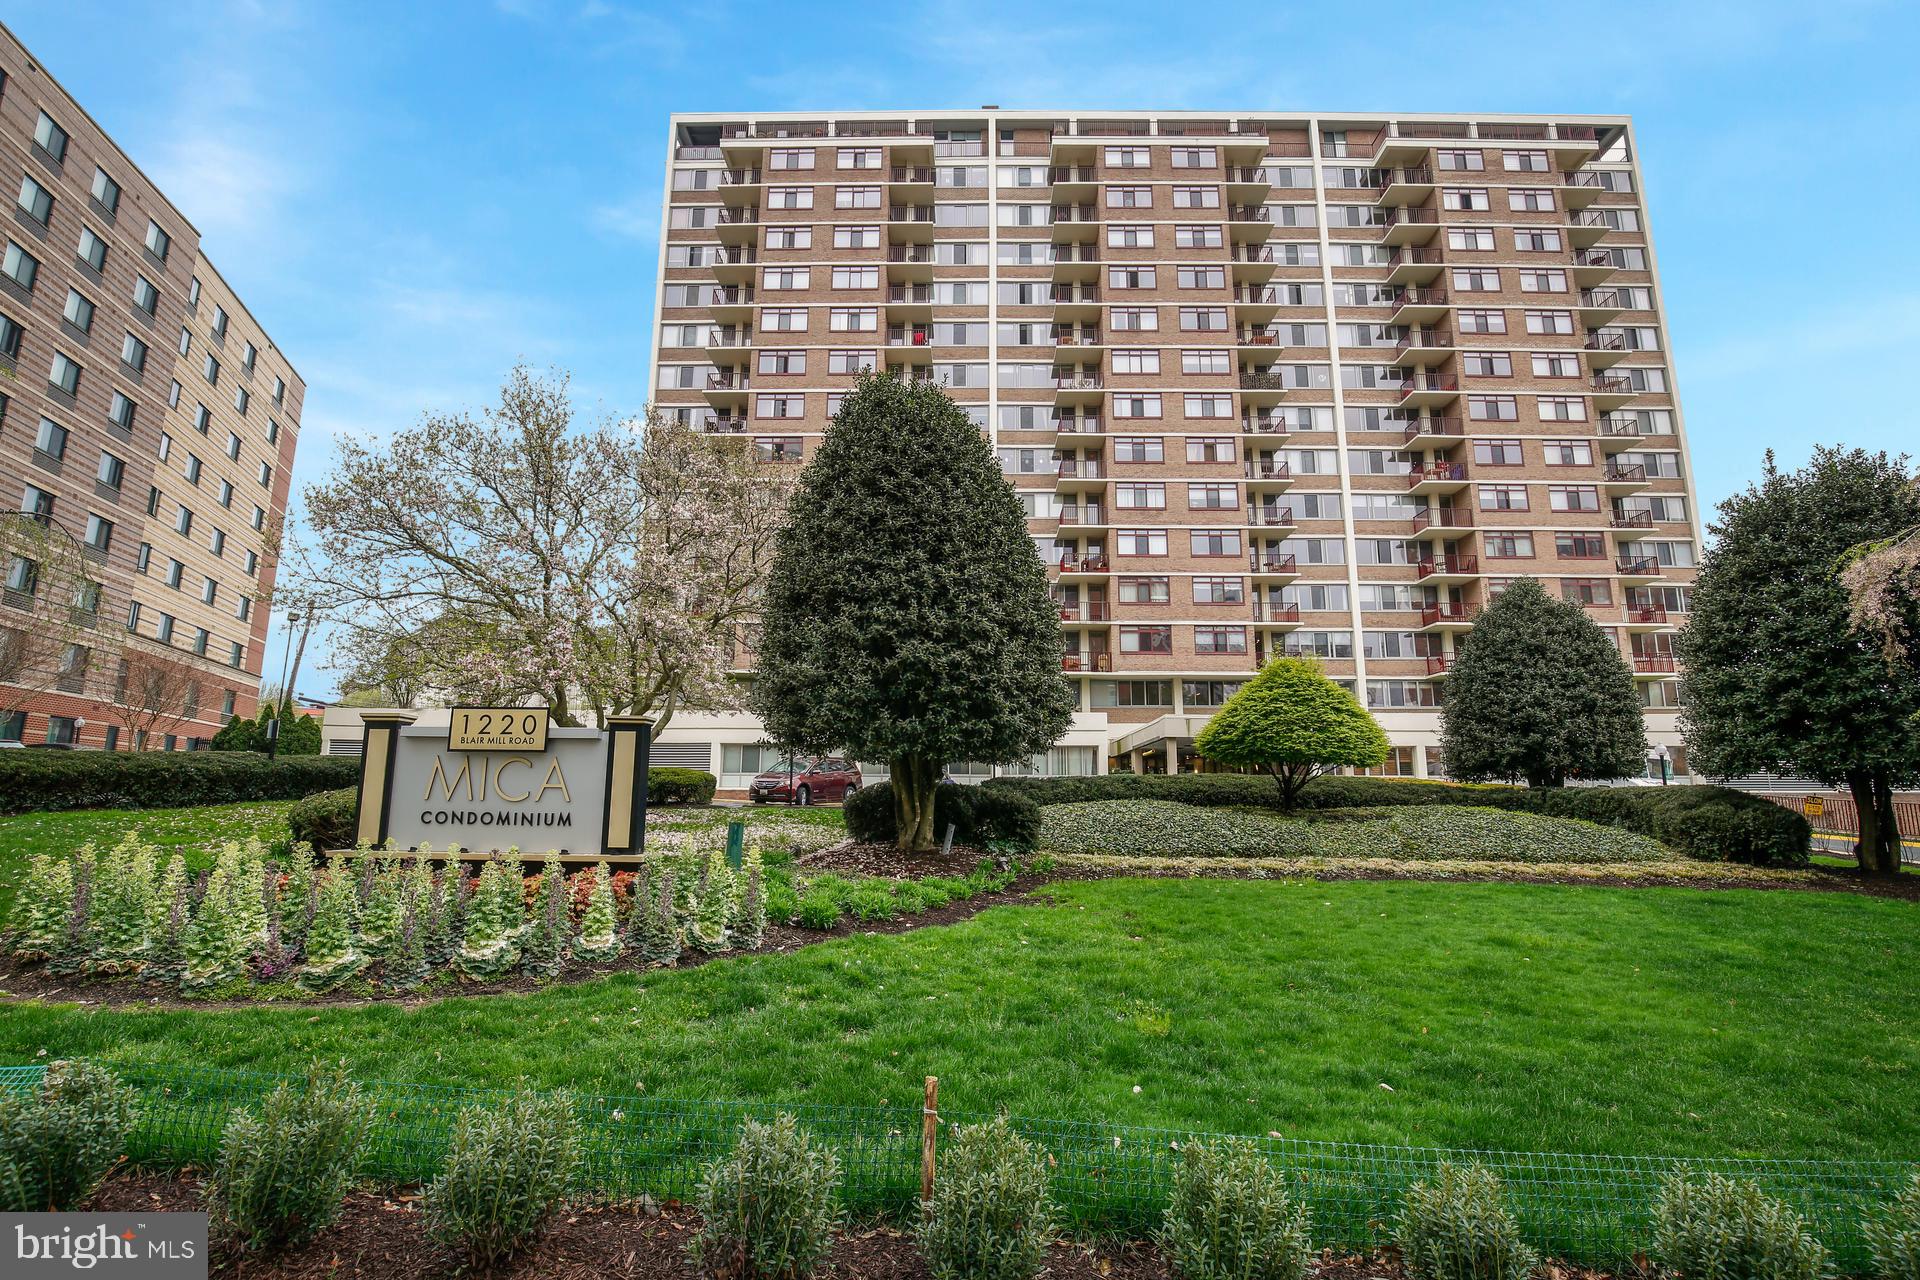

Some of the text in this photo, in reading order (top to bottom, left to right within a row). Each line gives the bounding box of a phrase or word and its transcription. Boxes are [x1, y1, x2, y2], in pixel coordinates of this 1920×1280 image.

[463, 714, 537, 735] 1220
[460, 736, 535, 745] BLAIR MILL ROAD
[424, 755, 571, 802] MICA
[420, 810, 572, 827] CONDOMINIUM
